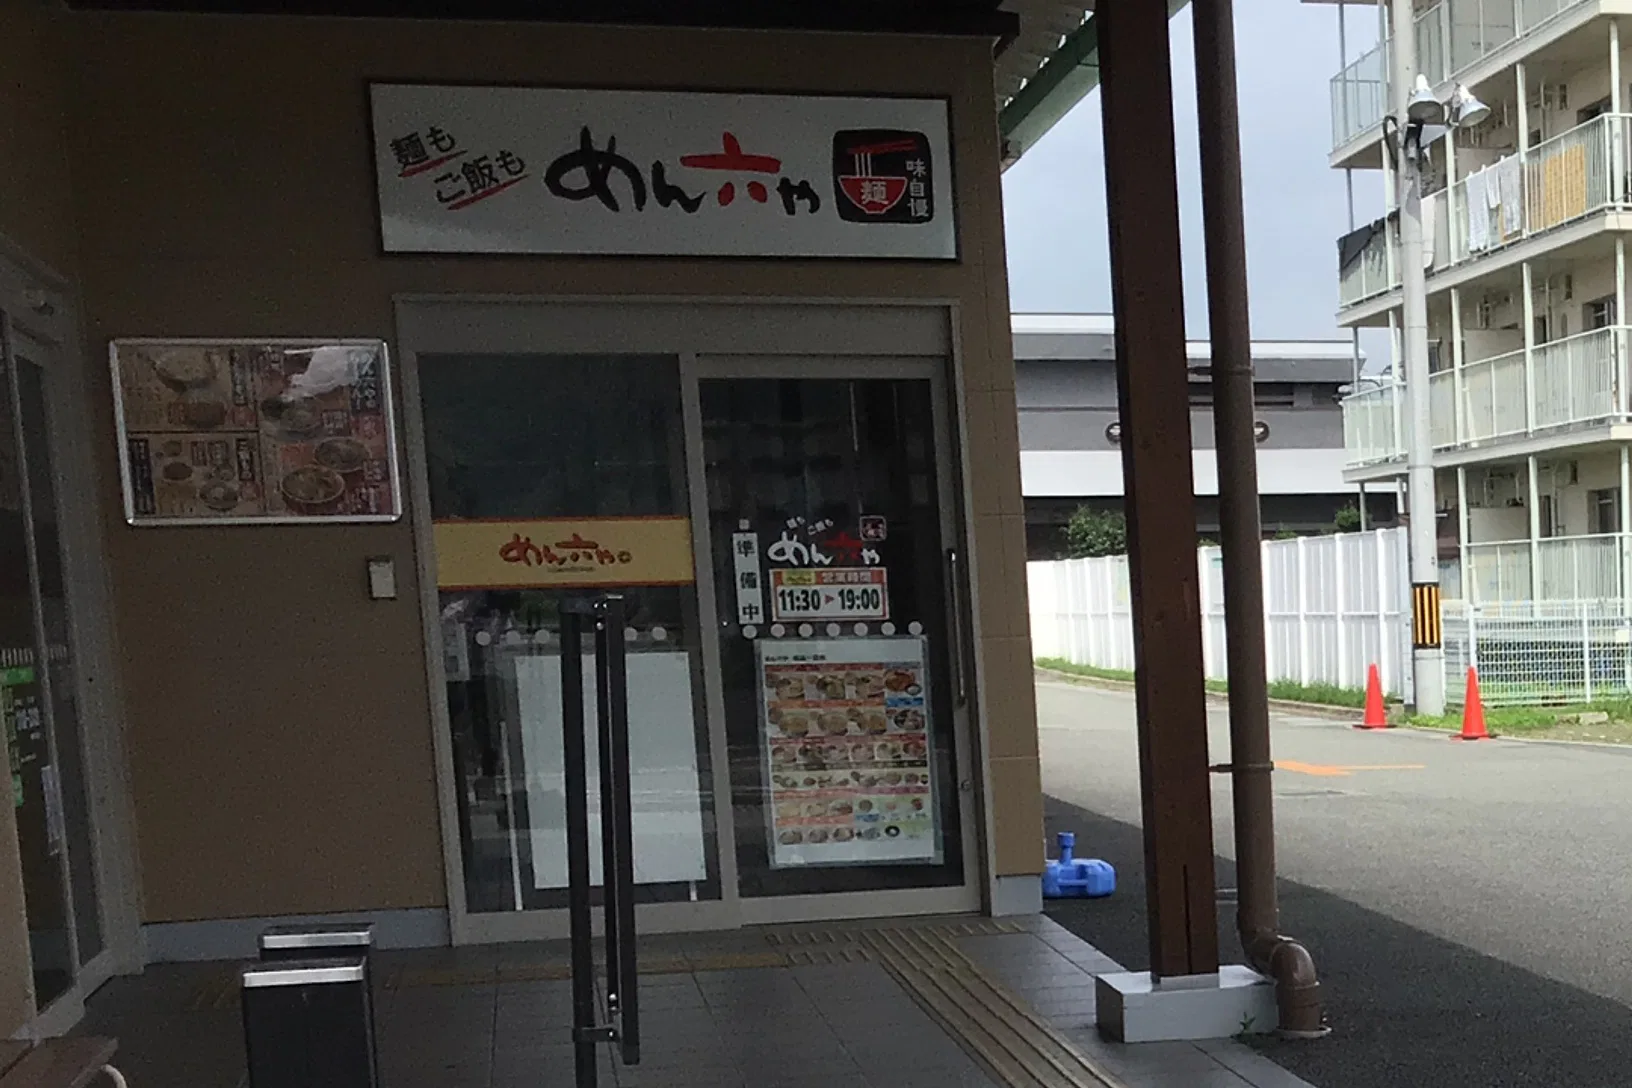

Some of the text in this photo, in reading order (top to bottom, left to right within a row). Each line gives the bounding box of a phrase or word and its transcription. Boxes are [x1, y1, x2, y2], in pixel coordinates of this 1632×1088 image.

[434, 150, 526, 203] ご飯も
[544, 125, 819, 214] めん六や
[905, 157, 929, 217] 味自慢
[736, 540, 759, 620] 準備中
[779, 588, 880, 611] 11:30 19:00
